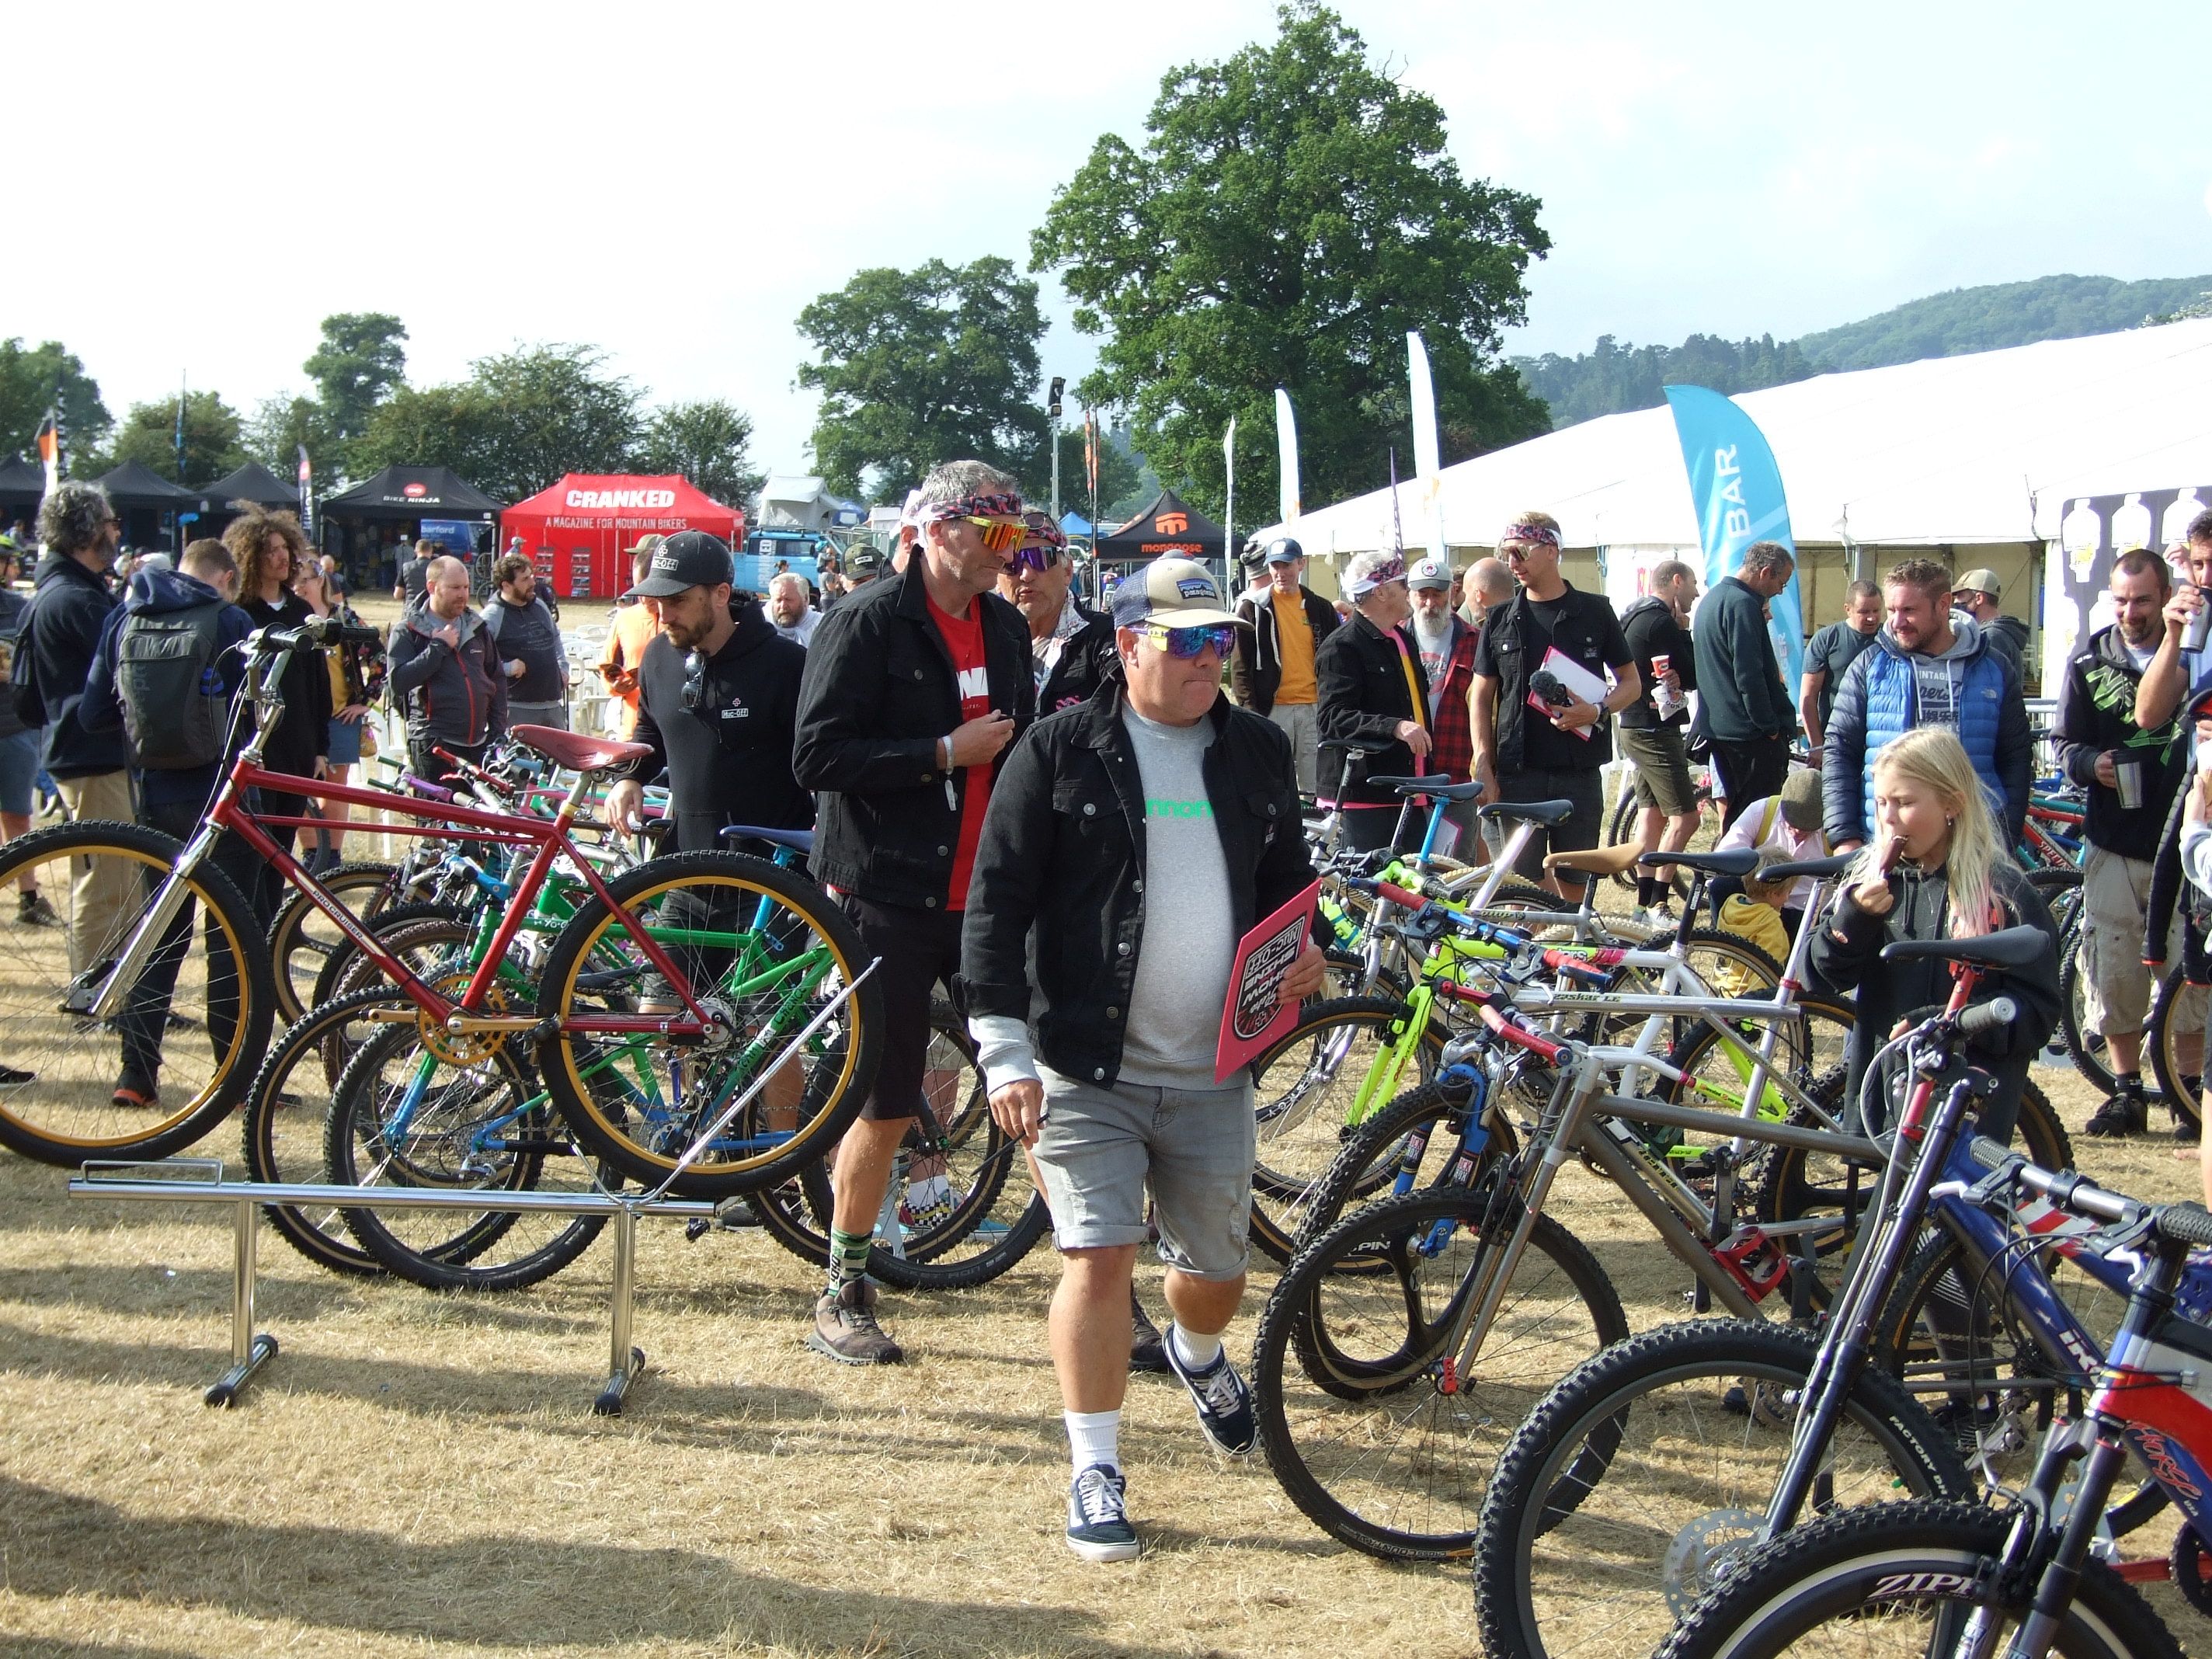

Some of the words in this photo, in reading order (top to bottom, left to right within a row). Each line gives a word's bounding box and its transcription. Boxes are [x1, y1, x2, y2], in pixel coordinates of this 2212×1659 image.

[566, 490, 675, 508] CRANKED
[1715, 443, 1751, 538] BAR
[545, 518, 551, 527] A
[553, 518, 593, 528] MAGAZINE
[596, 519, 613, 528] FOR
[615, 519, 656, 529] MOUNTAIN
[657, 520, 687, 530] BIKERS
[329, 904, 363, 940] CRUISER
[1244, 945, 1296, 991] SHINE
[1353, 1241, 1390, 1252] PIN
[1889, 1415, 1936, 1472] FACTORY
[1933, 1475, 1948, 1494] DH
